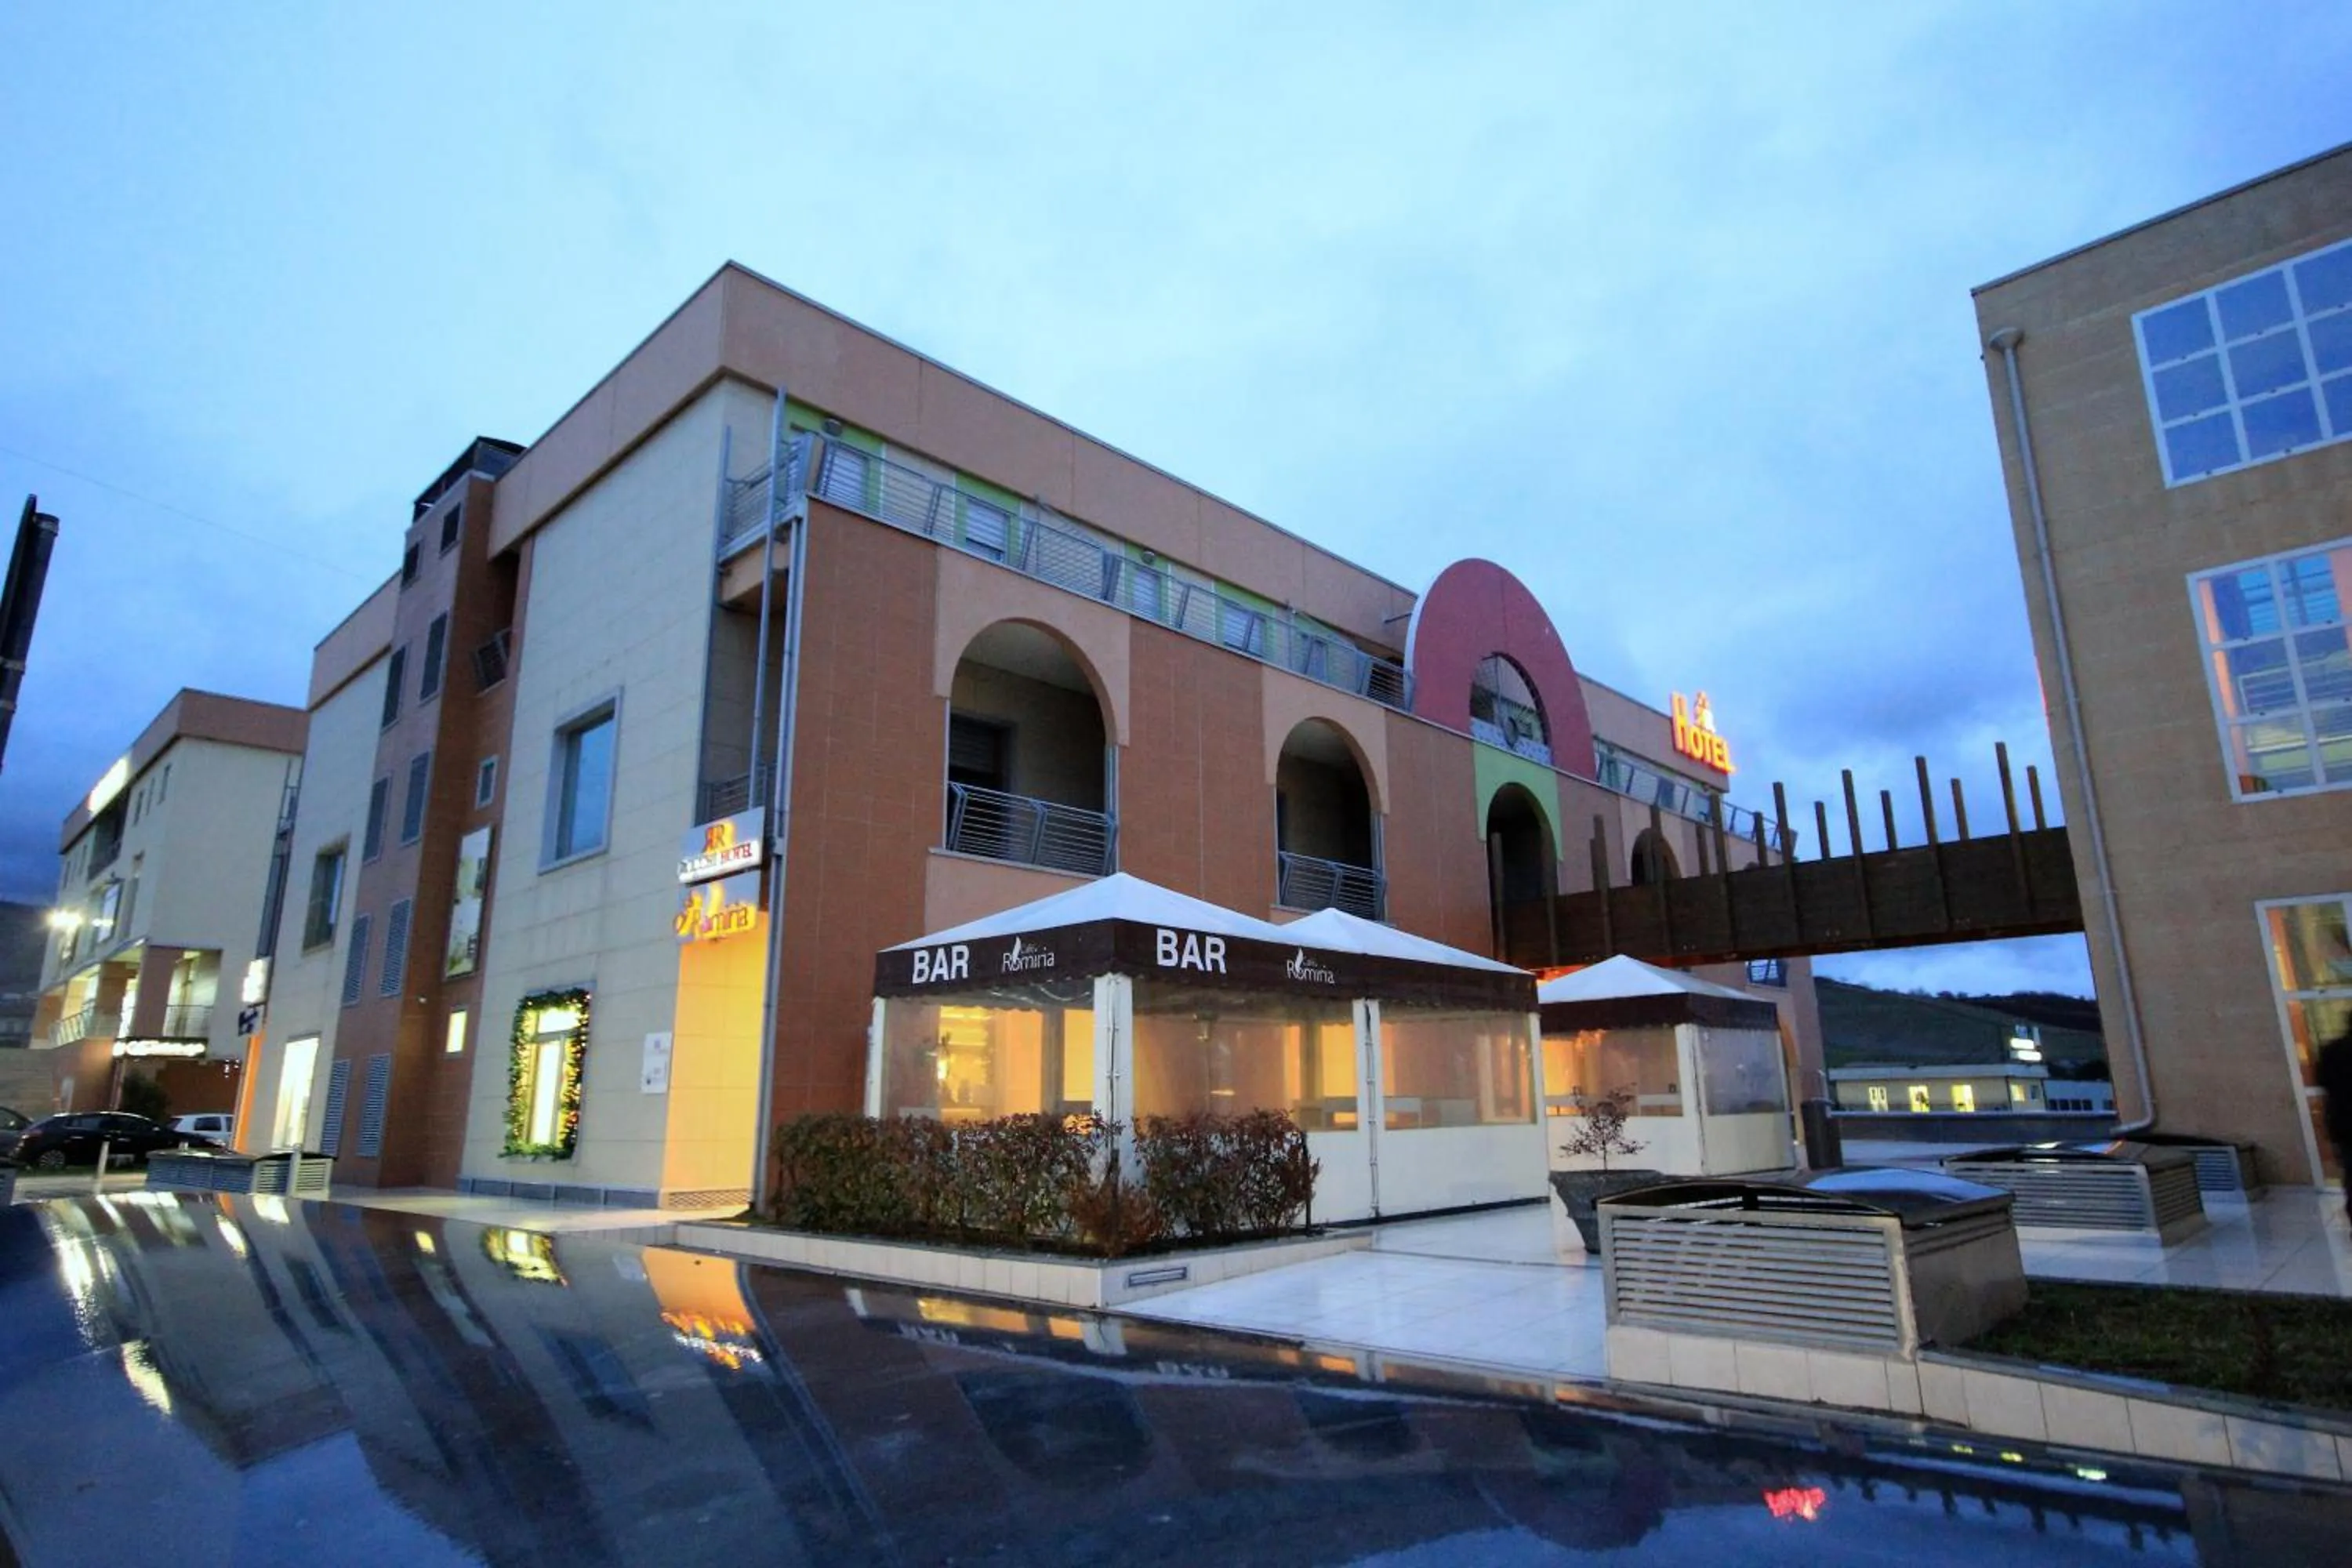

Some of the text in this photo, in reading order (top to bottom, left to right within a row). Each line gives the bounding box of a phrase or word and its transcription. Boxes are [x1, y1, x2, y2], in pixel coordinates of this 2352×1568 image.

[1670, 692, 1737, 773] HOTEL
[912, 945, 969, 984] BAR
[1002, 946, 1054, 972] Romina
[1156, 929, 1226, 974] BAR
[1287, 959, 1336, 985] Romina
